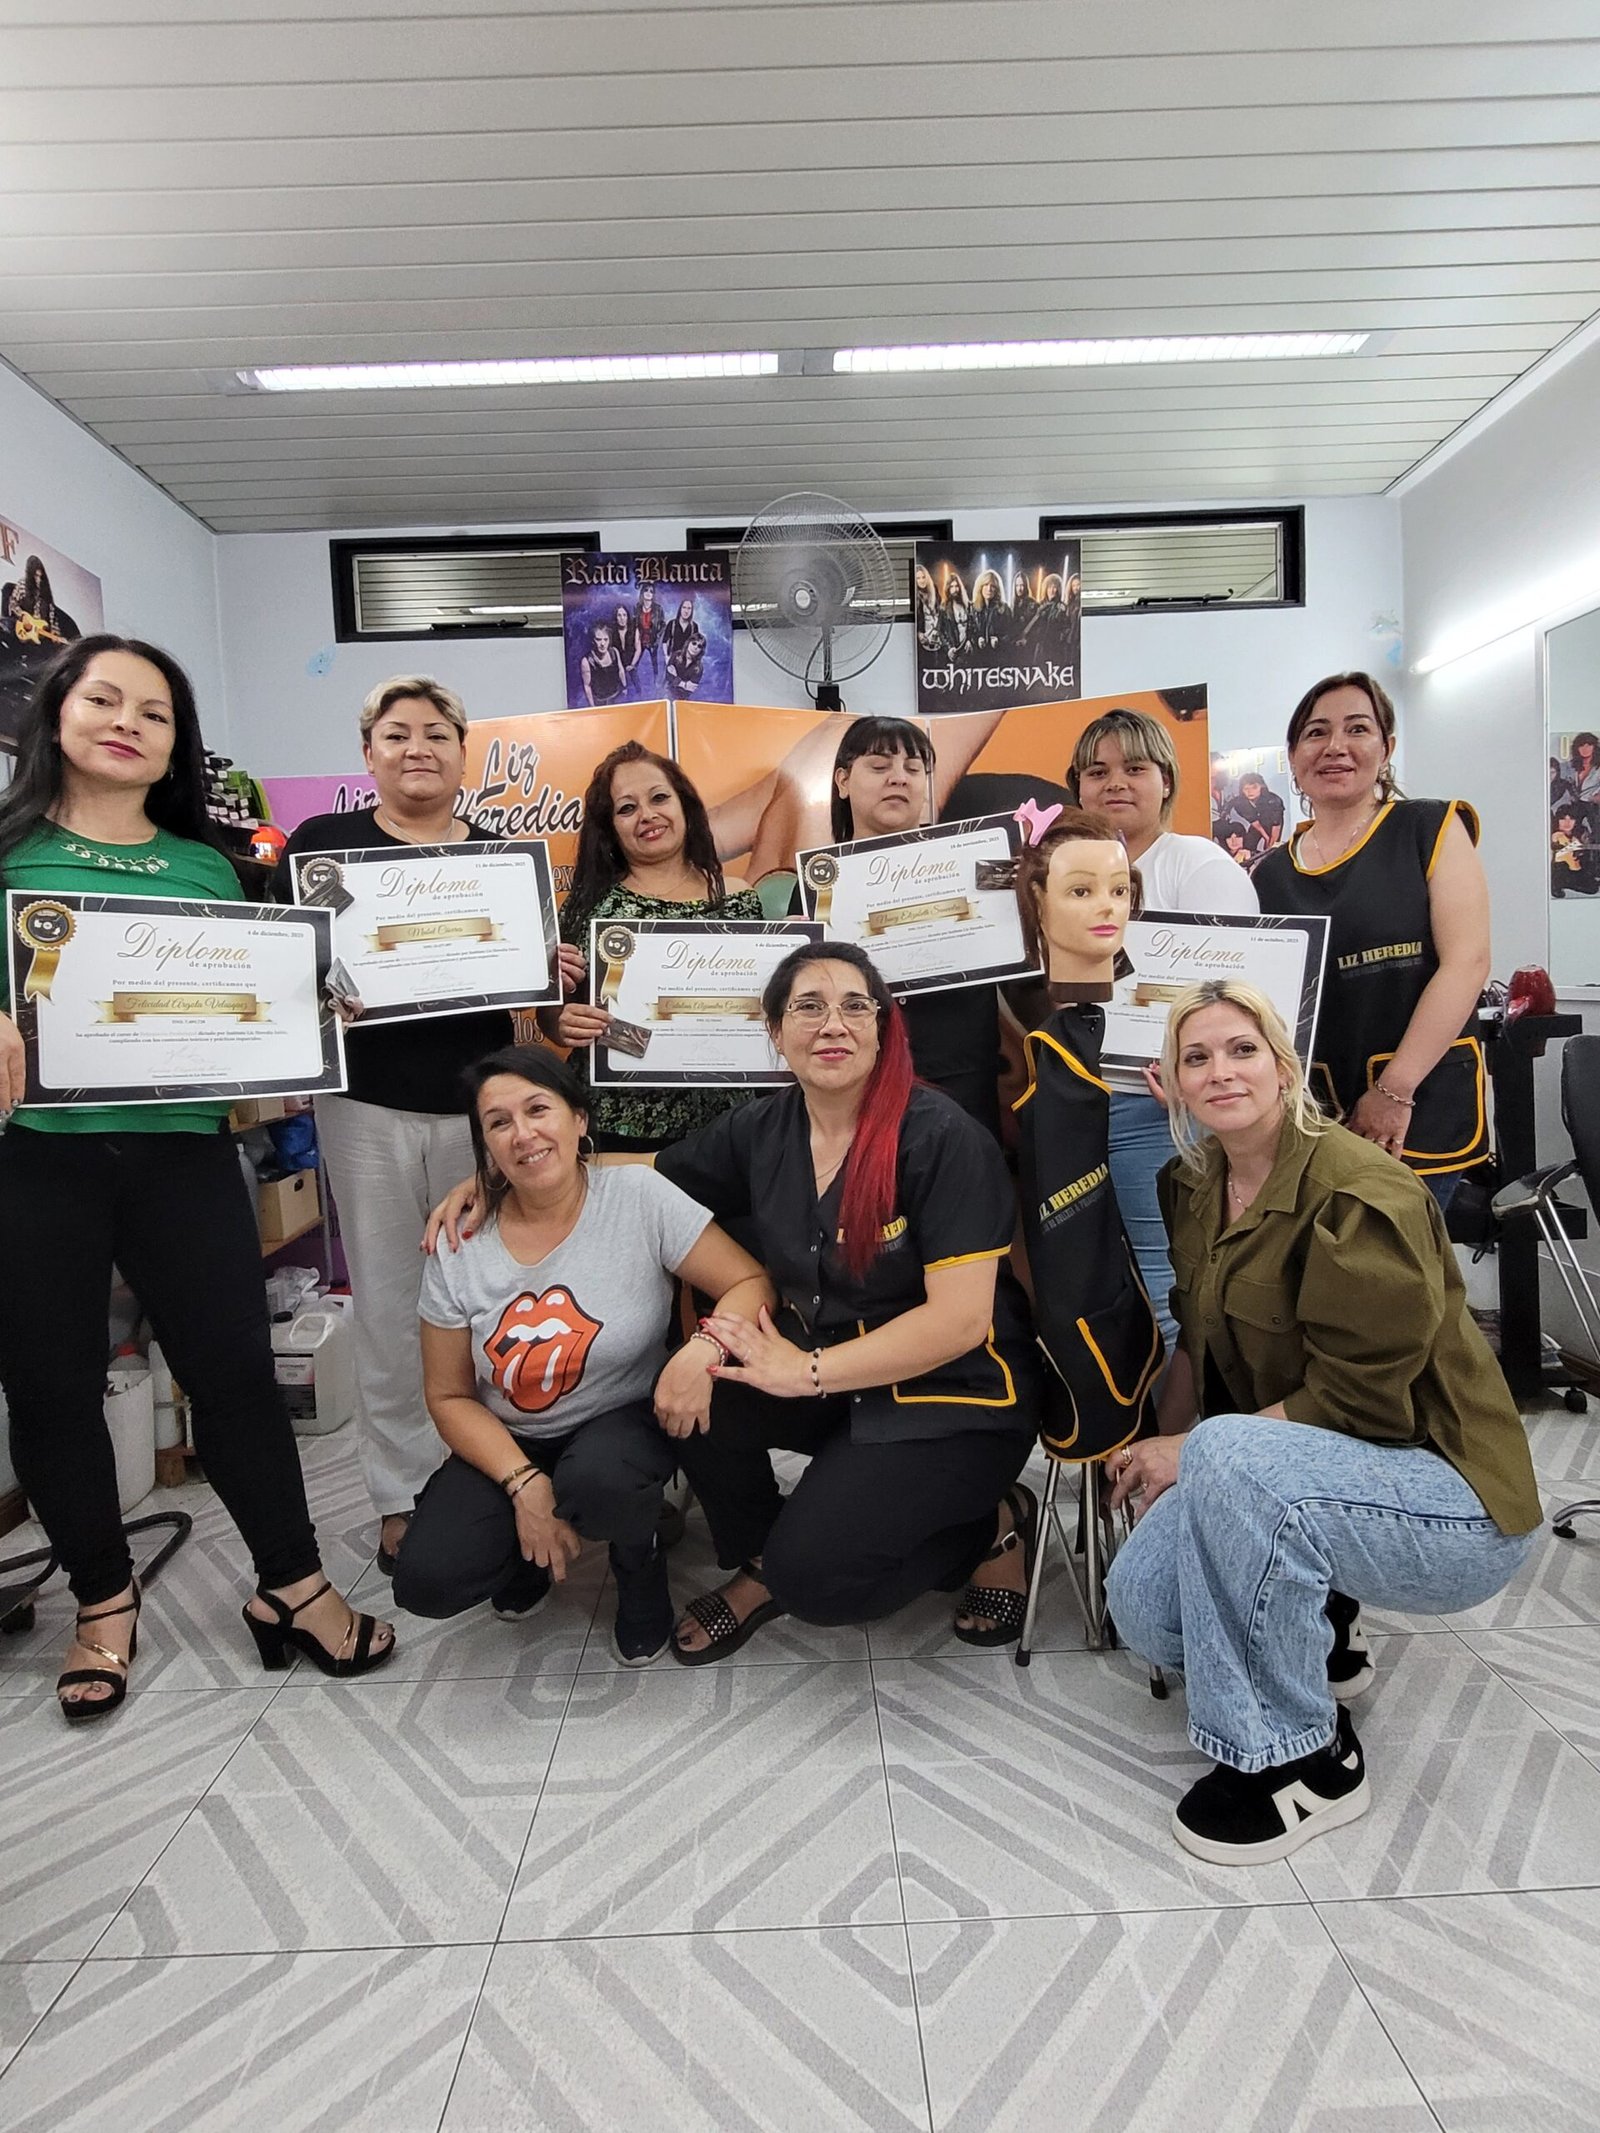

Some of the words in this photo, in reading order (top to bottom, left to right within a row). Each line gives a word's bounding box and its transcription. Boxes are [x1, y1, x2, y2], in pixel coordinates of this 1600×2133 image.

[565, 557, 629, 585] Rata
[635, 556, 724, 586] Blanca
[473, 738, 540, 808] Liz
[376, 866, 482, 907] Diploma
[866, 853, 957, 892] Diploma
[914, 877, 922, 885] de
[924, 872, 960, 884] aprobación
[432, 893, 441, 901] de
[443, 891, 484, 901] aprobación
[117, 921, 250, 971] Diploma
[203, 961, 252, 970] aprobación
[661, 940, 755, 980] Diploma
[1144, 929, 1245, 969] Diploma
[1337, 953, 1359, 970] LIZ
